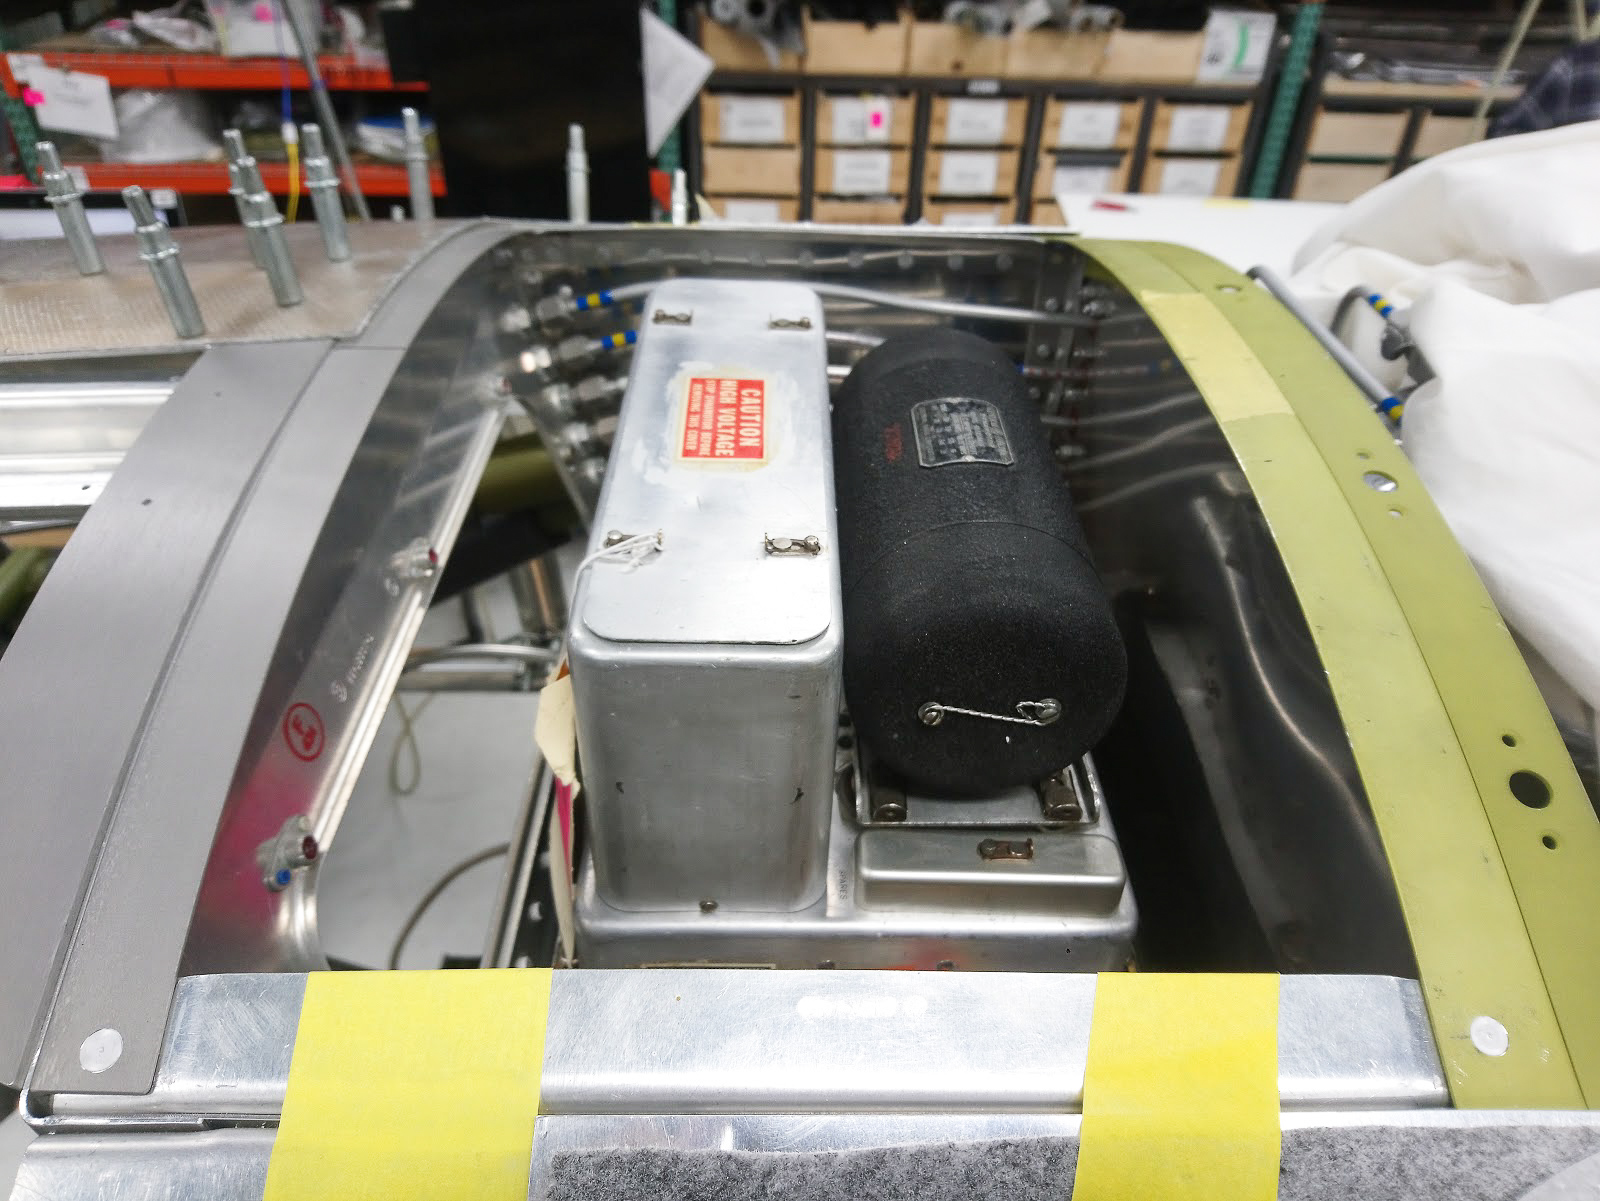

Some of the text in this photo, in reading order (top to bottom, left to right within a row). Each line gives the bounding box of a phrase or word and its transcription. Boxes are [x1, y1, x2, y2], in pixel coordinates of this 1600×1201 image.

[685, 384, 702, 450] REMOVING THIS COVER
[699, 379, 716, 455] STOP DYNAMOTOR BEFORE
[715, 380, 737, 456] HIGH VOLTAGE
[741, 390, 761, 446] CAUTION
